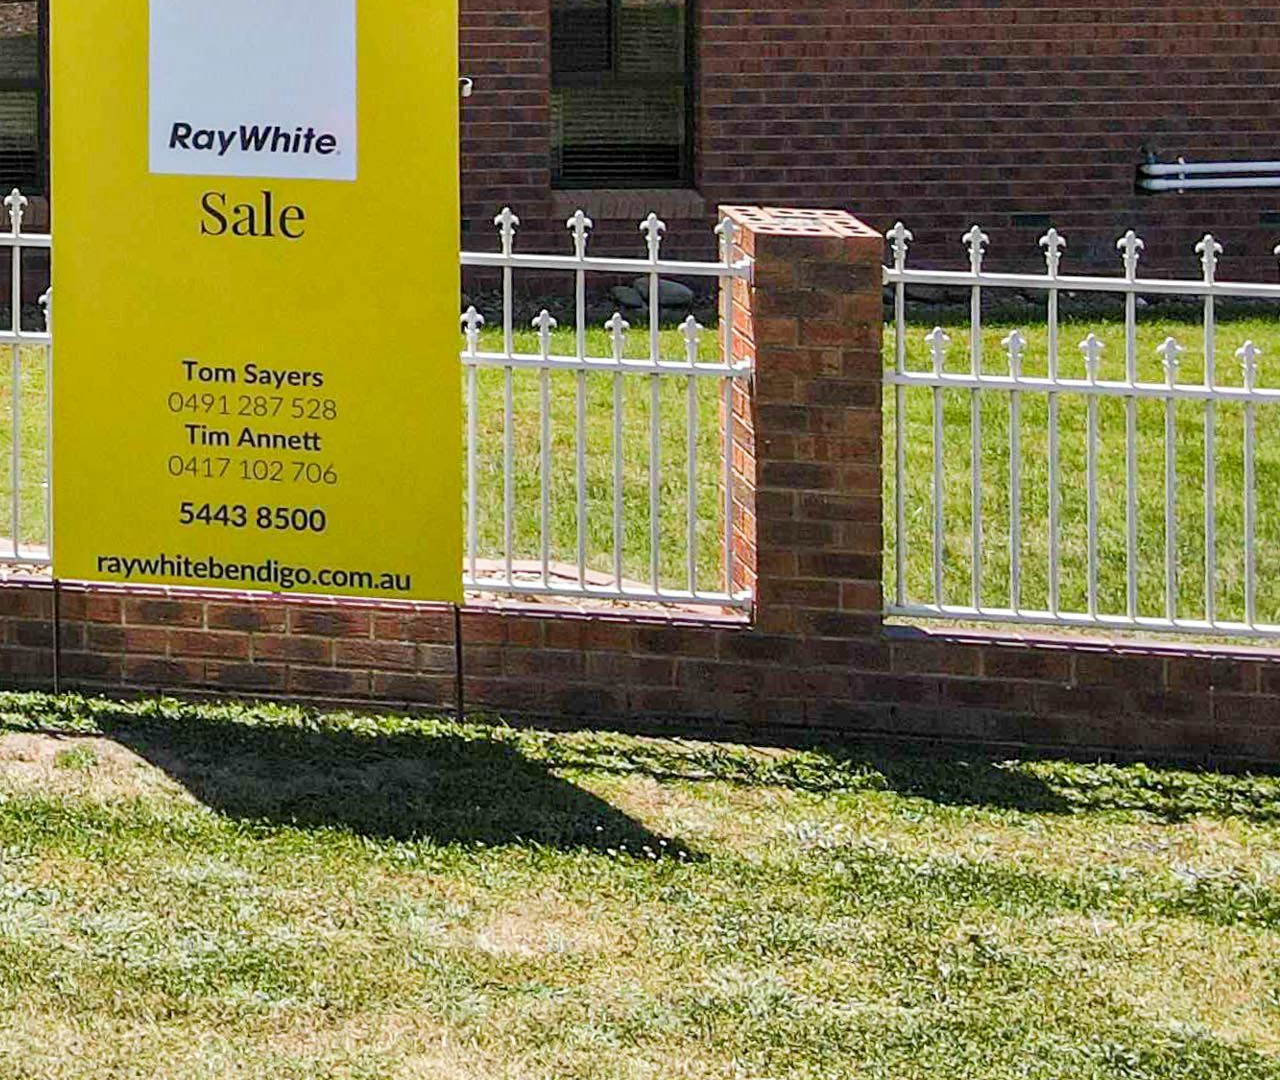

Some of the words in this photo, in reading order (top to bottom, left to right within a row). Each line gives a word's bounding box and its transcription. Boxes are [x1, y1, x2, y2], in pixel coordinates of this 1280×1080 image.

[200, 190, 306, 239] Sale
[182, 360, 236, 383] Tom
[243, 363, 324, 389] Sayers
[167, 391, 231, 416] 0491
[237, 394, 284, 417] 287
[291, 397, 338, 421] 528
[184, 424, 230, 447] Tim
[237, 426, 322, 452] Annett
[167, 455, 231, 479] 0417
[239, 459, 284, 482] 102
[291, 461, 338, 485] 706
[179, 501, 248, 528] 5443
[256, 506, 327, 533] 8500
[96, 552, 412, 592] raywhitebendigo.com.au
